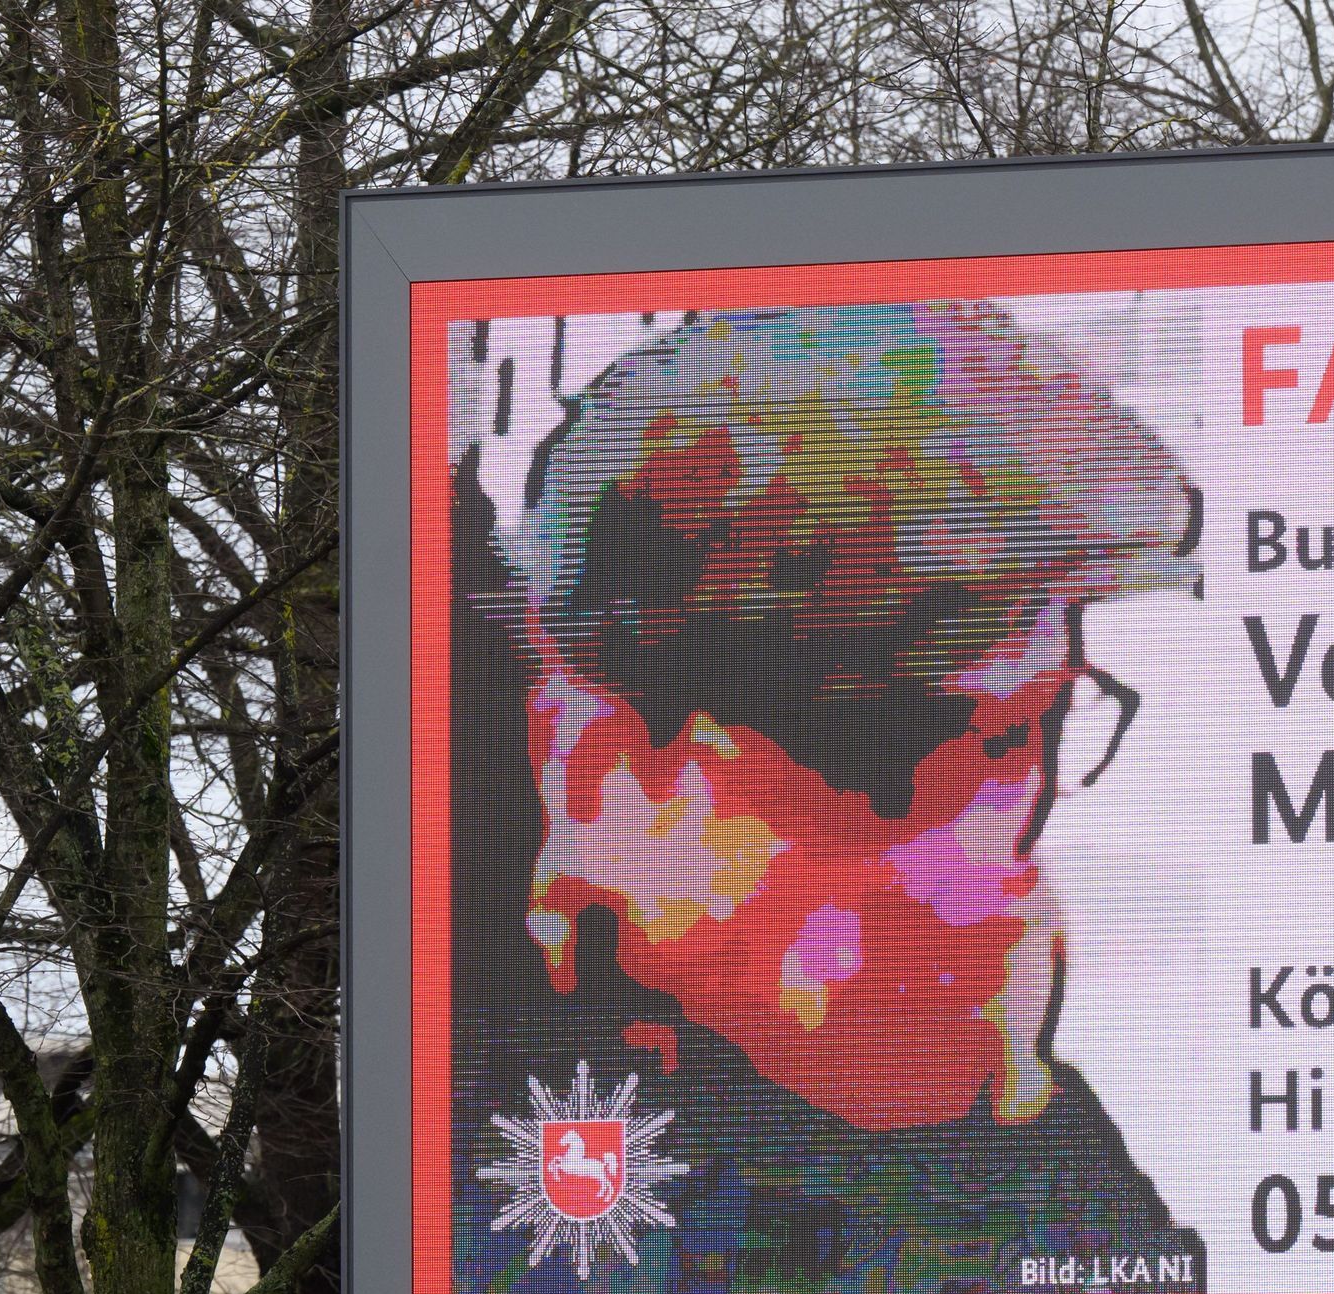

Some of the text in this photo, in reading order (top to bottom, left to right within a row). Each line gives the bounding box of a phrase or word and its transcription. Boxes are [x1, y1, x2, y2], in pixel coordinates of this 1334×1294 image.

[1021, 1254, 1193, 1286] Bild: LKA NI
